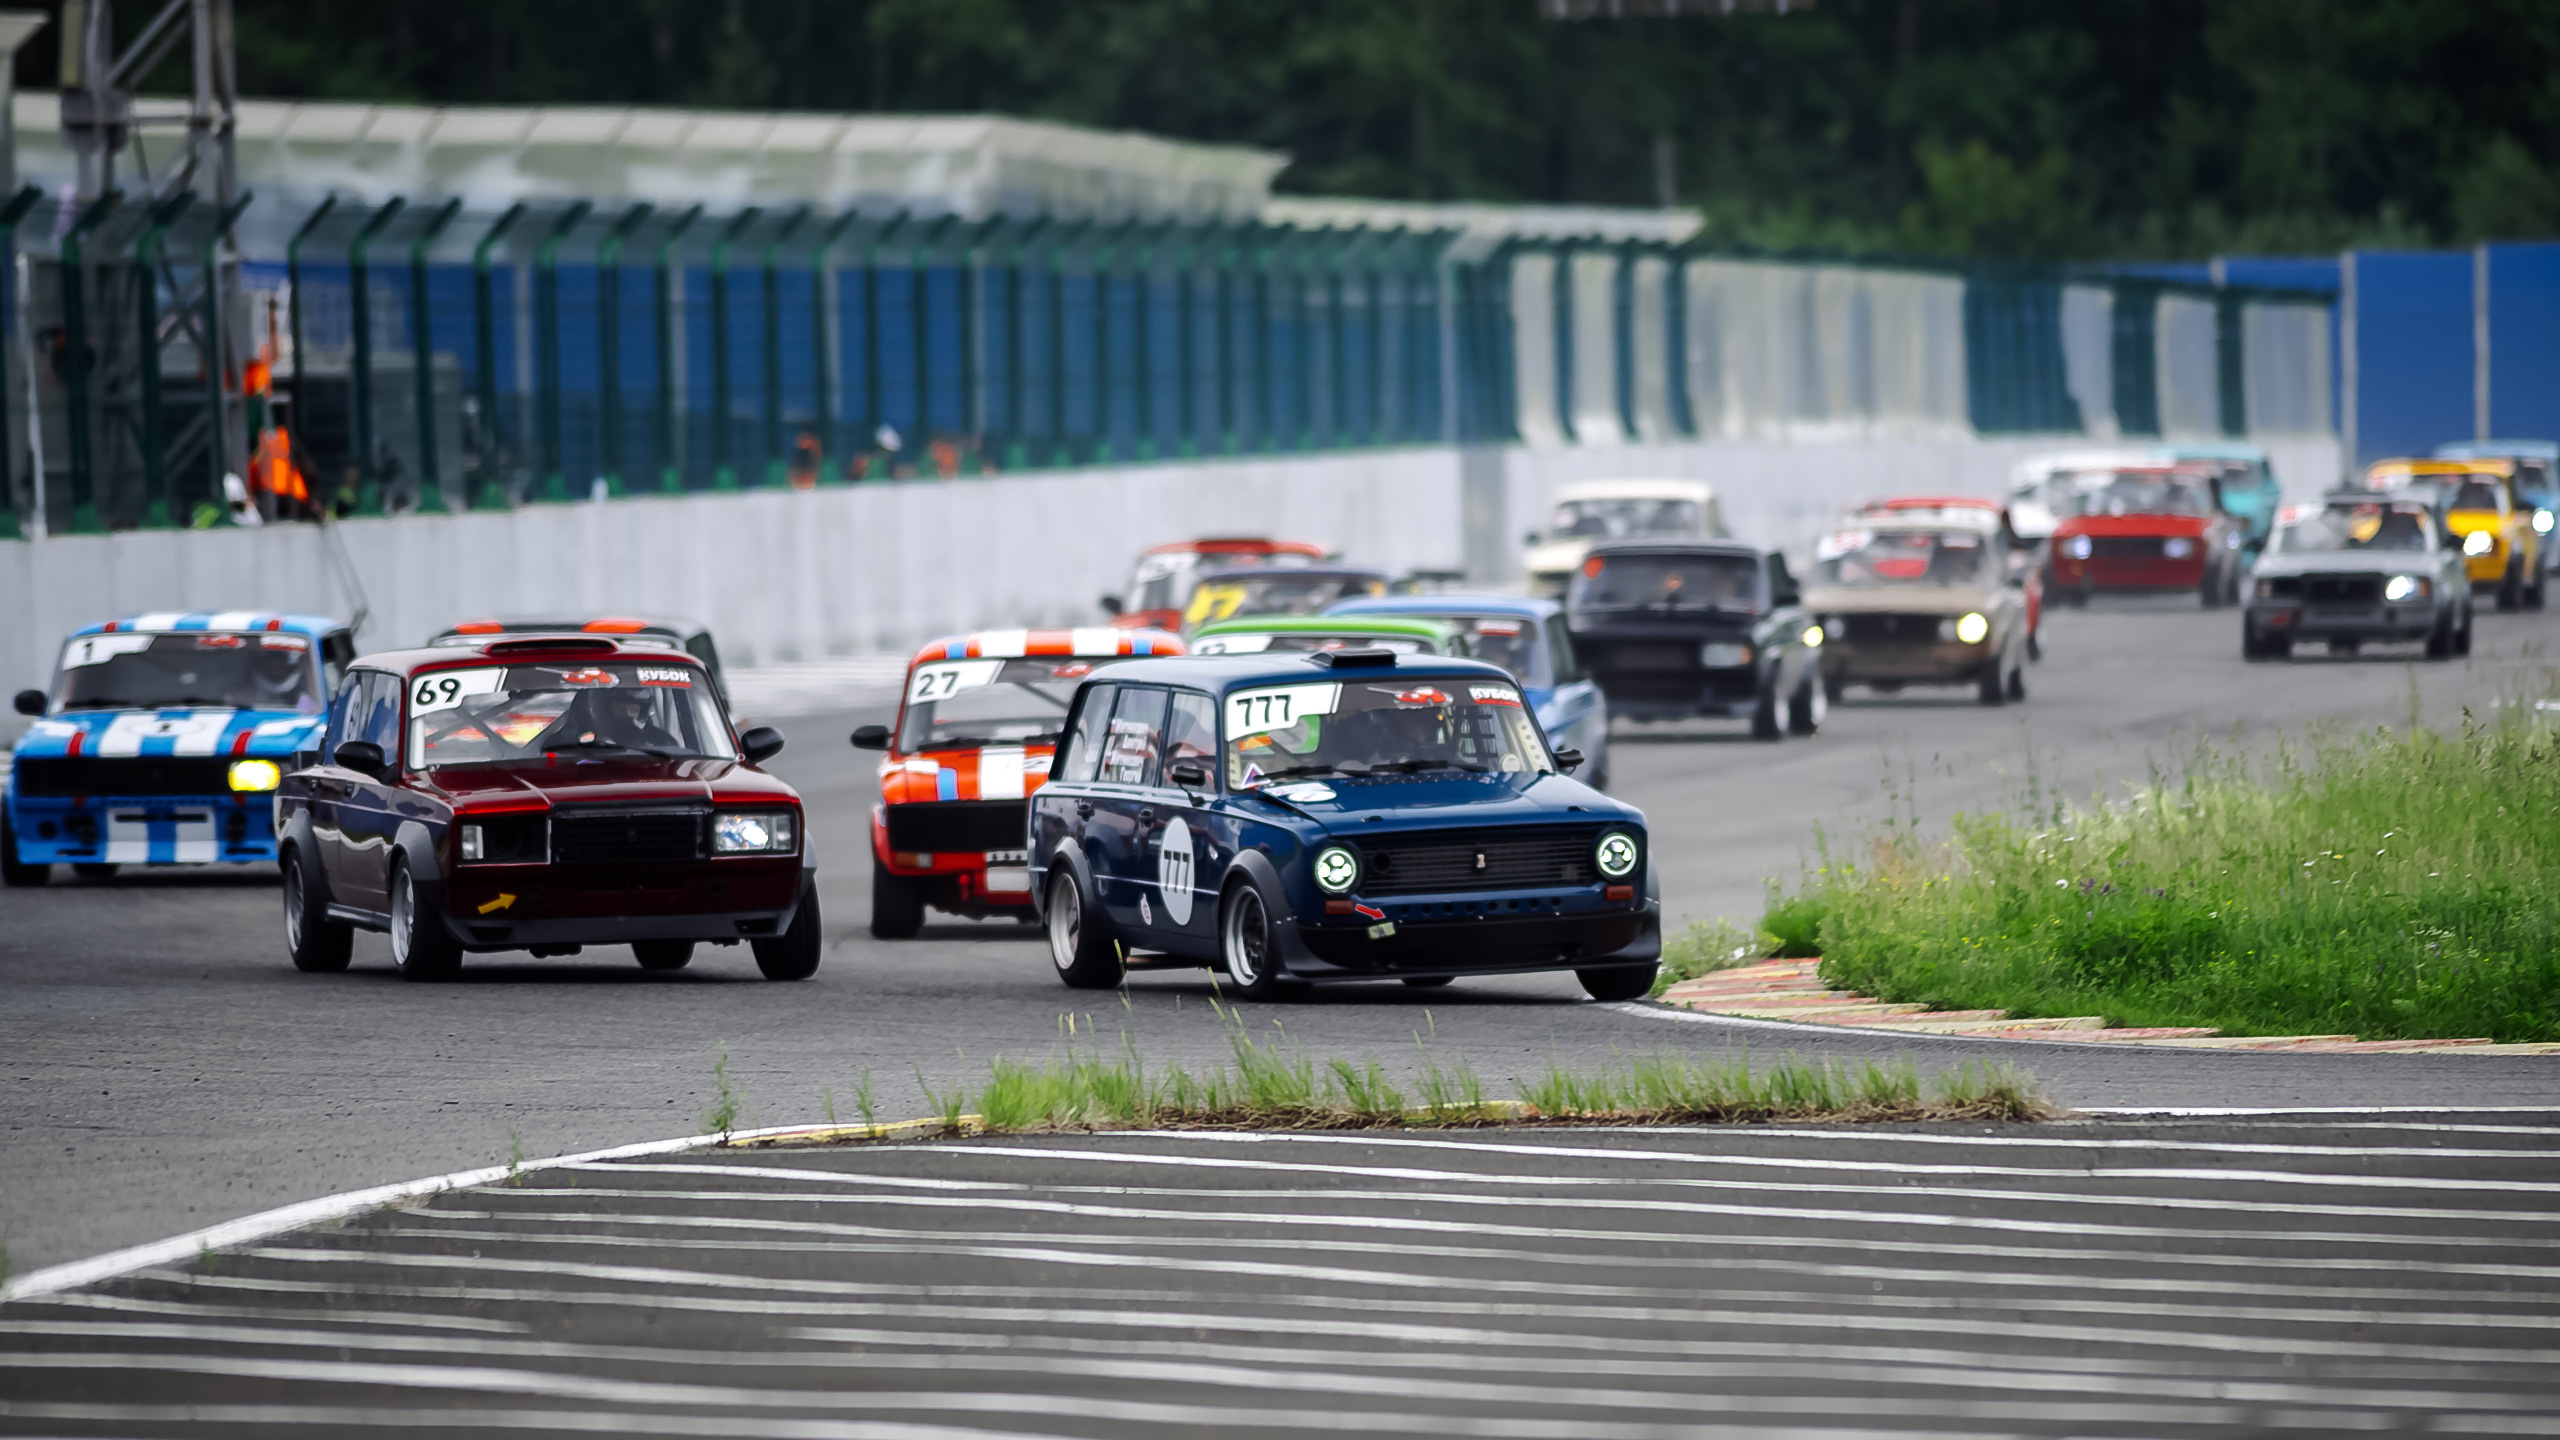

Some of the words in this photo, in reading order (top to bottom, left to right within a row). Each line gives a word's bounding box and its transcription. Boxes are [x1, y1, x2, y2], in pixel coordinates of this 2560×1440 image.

[638, 669, 691, 682] КУБОК
[918, 671, 960, 697] 27
[415, 678, 461, 705] 69
[1469, 686, 1520, 701] КУБОК
[1236, 694, 1291, 727] 777
[1163, 850, 1190, 895] 777
